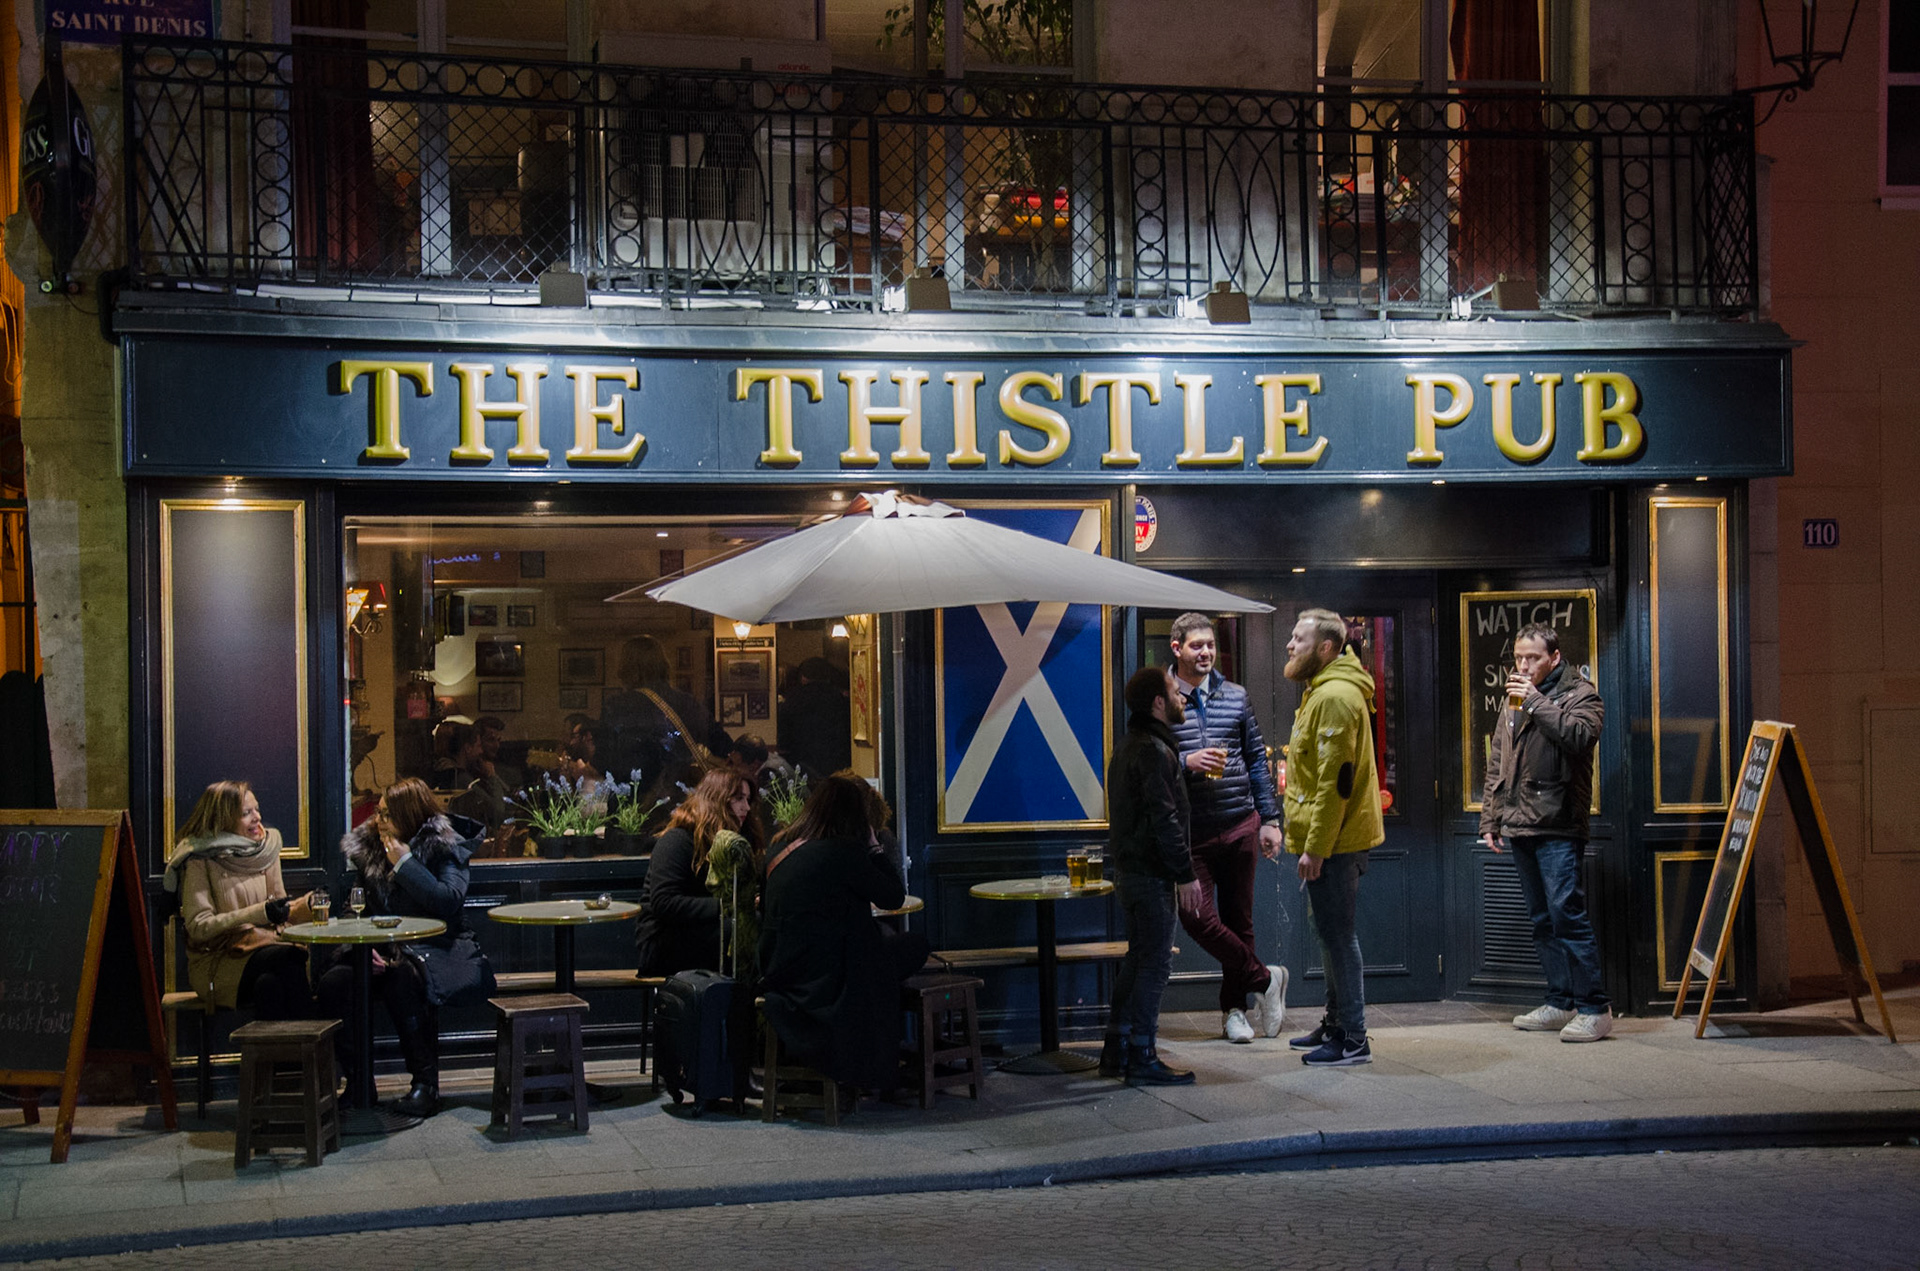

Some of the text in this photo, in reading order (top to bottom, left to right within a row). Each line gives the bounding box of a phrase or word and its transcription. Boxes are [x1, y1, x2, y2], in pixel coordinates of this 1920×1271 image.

[52, 10, 207, 38] SAINT DENIS
[340, 360, 1643, 465] THE THISTLE PUB
[1805, 522, 1836, 546] 110
[1476, 602, 1573, 636] WATCH
